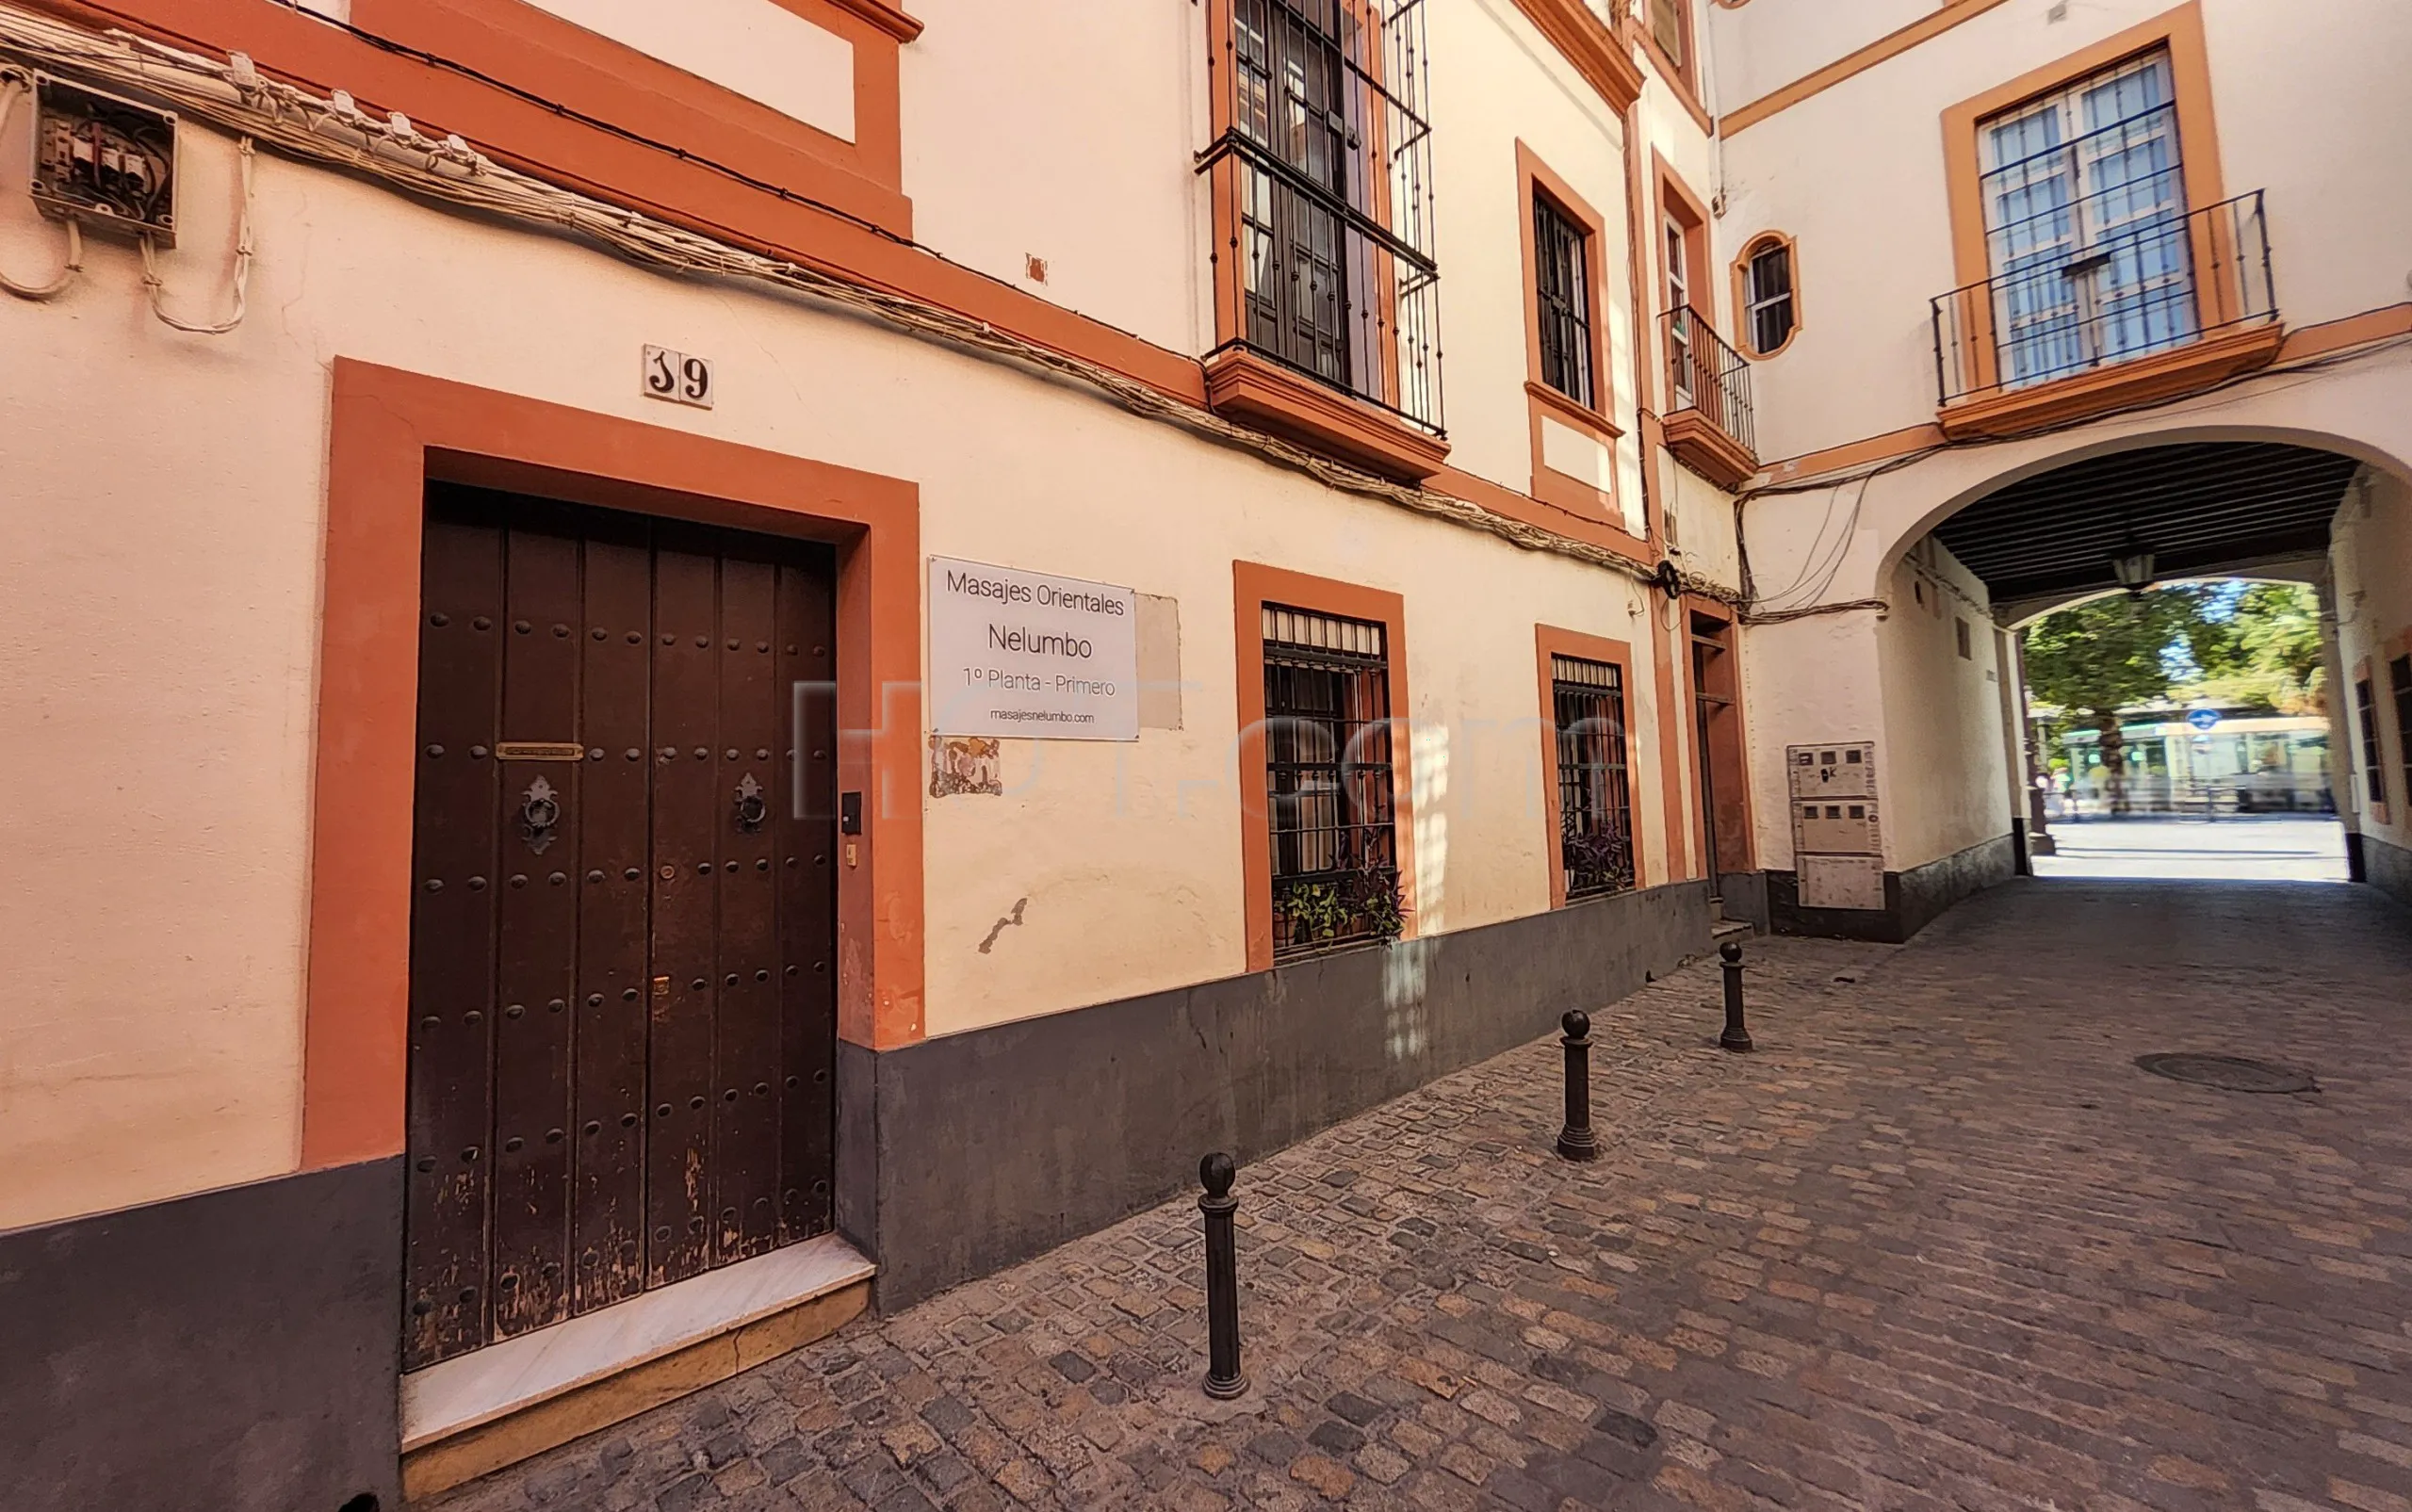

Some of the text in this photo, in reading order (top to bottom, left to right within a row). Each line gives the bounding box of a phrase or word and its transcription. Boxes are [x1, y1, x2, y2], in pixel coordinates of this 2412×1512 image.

[946, 569, 1125, 616] Masajes Orientales
[988, 623, 1093, 658] Nelumbo
[988, 669, 1041, 691] Planta
[1055, 675, 1116, 697] Primero
[990, 708, 1095, 723] masajesnelumbo.com
